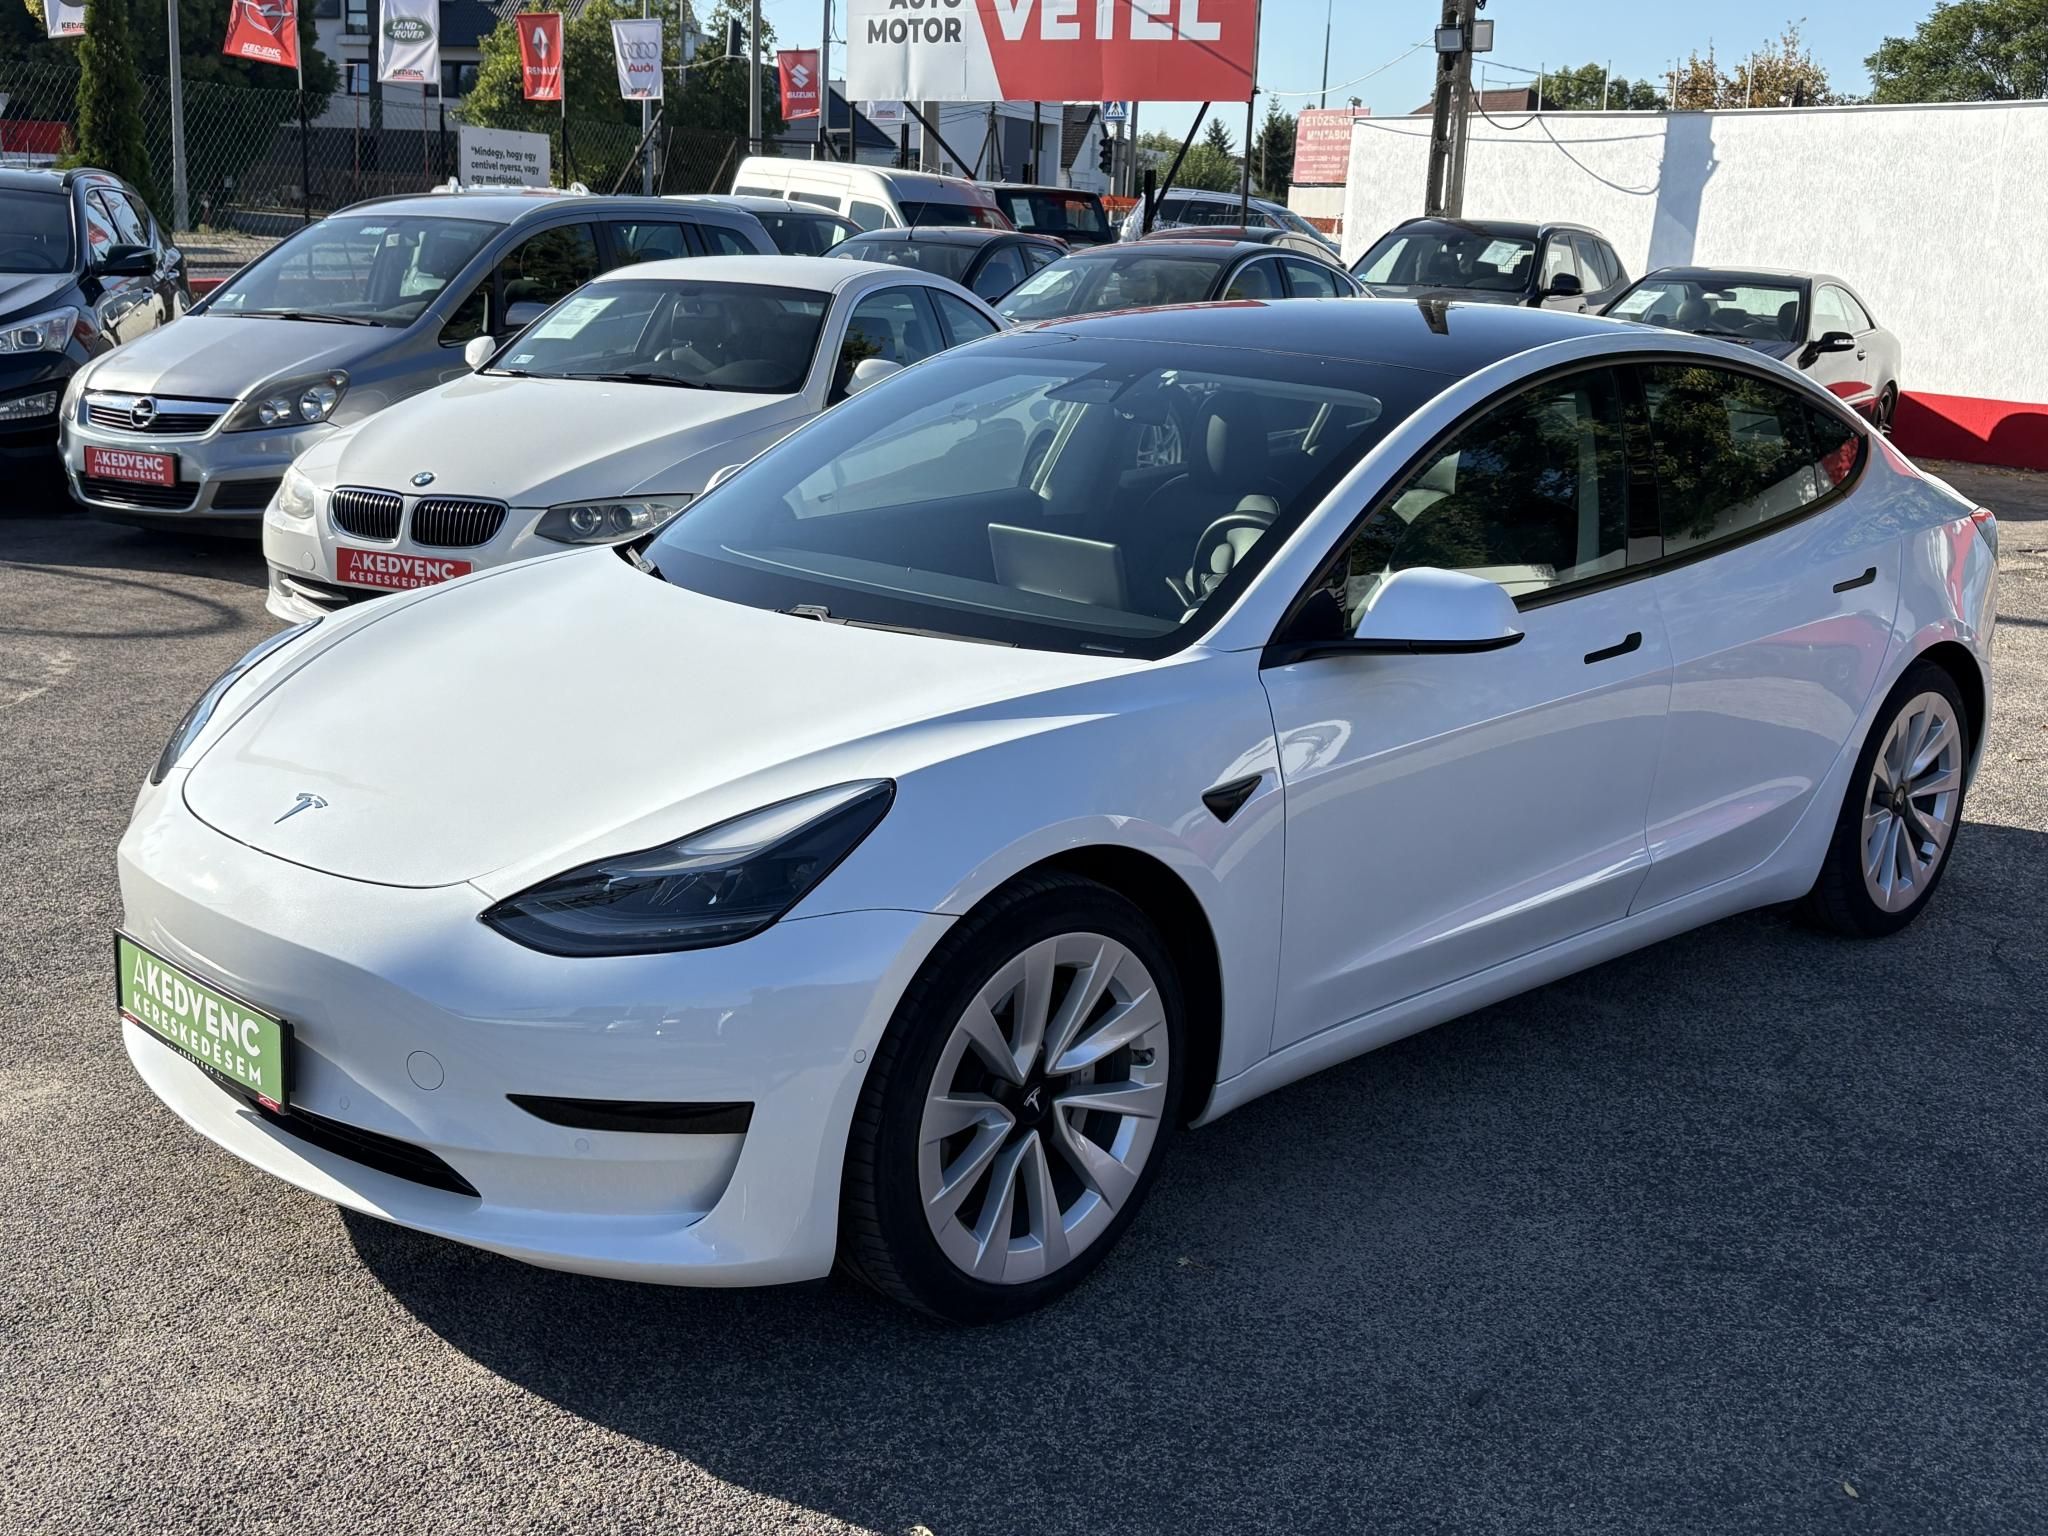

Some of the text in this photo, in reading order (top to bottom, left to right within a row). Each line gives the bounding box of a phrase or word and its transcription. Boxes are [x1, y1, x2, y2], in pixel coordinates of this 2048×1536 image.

[867, 17, 962, 44] MOTOR
[506, 149, 523, 160] hogy
[524, 152, 537, 162] egy
[500, 163, 523, 173] nyersz,
[524, 166, 540, 175] vagy
[471, 174, 485, 184] egy
[133, 991, 262, 1086] KERESKEDÉSEM
